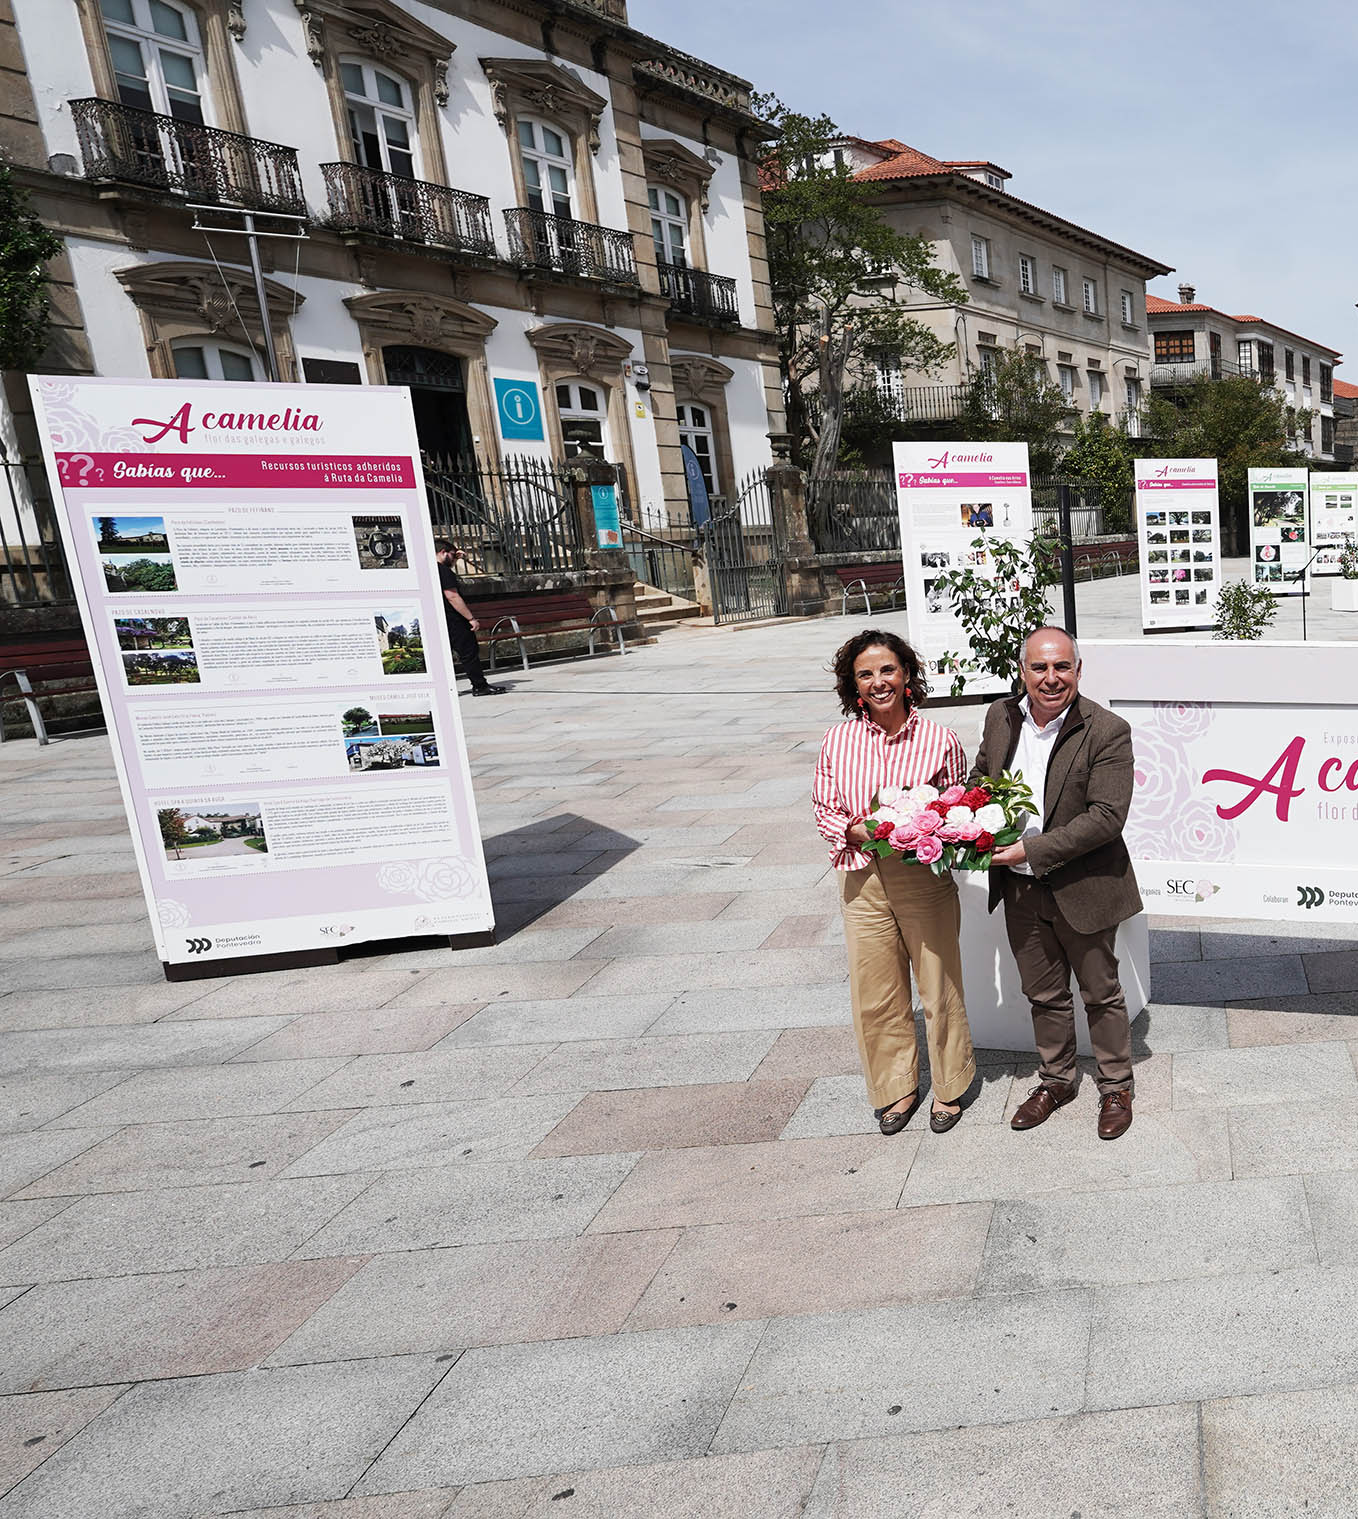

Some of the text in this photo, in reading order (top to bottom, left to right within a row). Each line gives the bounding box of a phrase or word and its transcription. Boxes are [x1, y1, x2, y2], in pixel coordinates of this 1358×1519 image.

[131, 402, 323, 444] A camelia
[261, 461, 305, 471] Recursos
[356, 462, 401, 472] adheridos
[927, 451, 993, 469] A camelia
[113, 461, 226, 483] Sabías que...
[331, 473, 353, 482] Ruta
[354, 473, 365, 482] da
[367, 473, 403, 483] Camelia
[1155, 466, 1168, 477] A
[1201, 735, 1306, 822] A
[1318, 801, 1347, 820] flor
[1166, 879, 1195, 895] SEC
[1262, 894, 1289, 903] Colaboran
